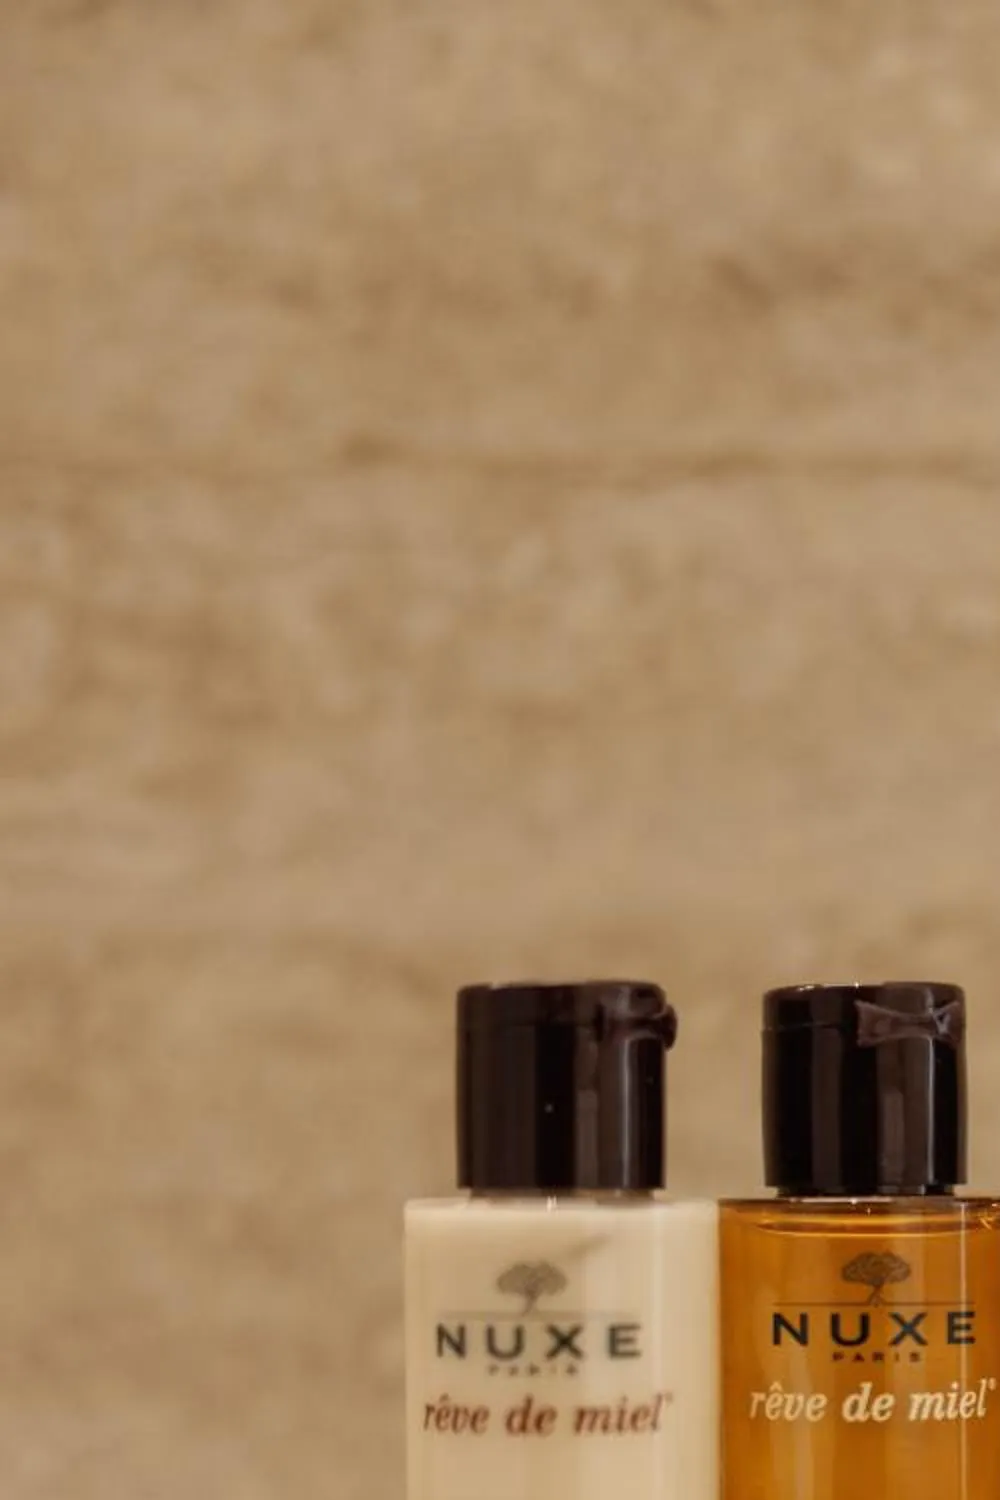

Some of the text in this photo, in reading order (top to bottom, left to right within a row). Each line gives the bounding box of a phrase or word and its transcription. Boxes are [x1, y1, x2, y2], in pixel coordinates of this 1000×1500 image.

[435, 1323, 642, 1359] NUXE
[771, 1311, 976, 1346] NUXE
[832, 1352, 921, 1363] PARIS
[422, 1393, 490, 1434] rêve
[504, 1394, 557, 1436] de
[749, 1381, 828, 1421] rêve
[842, 1381, 895, 1422] de
